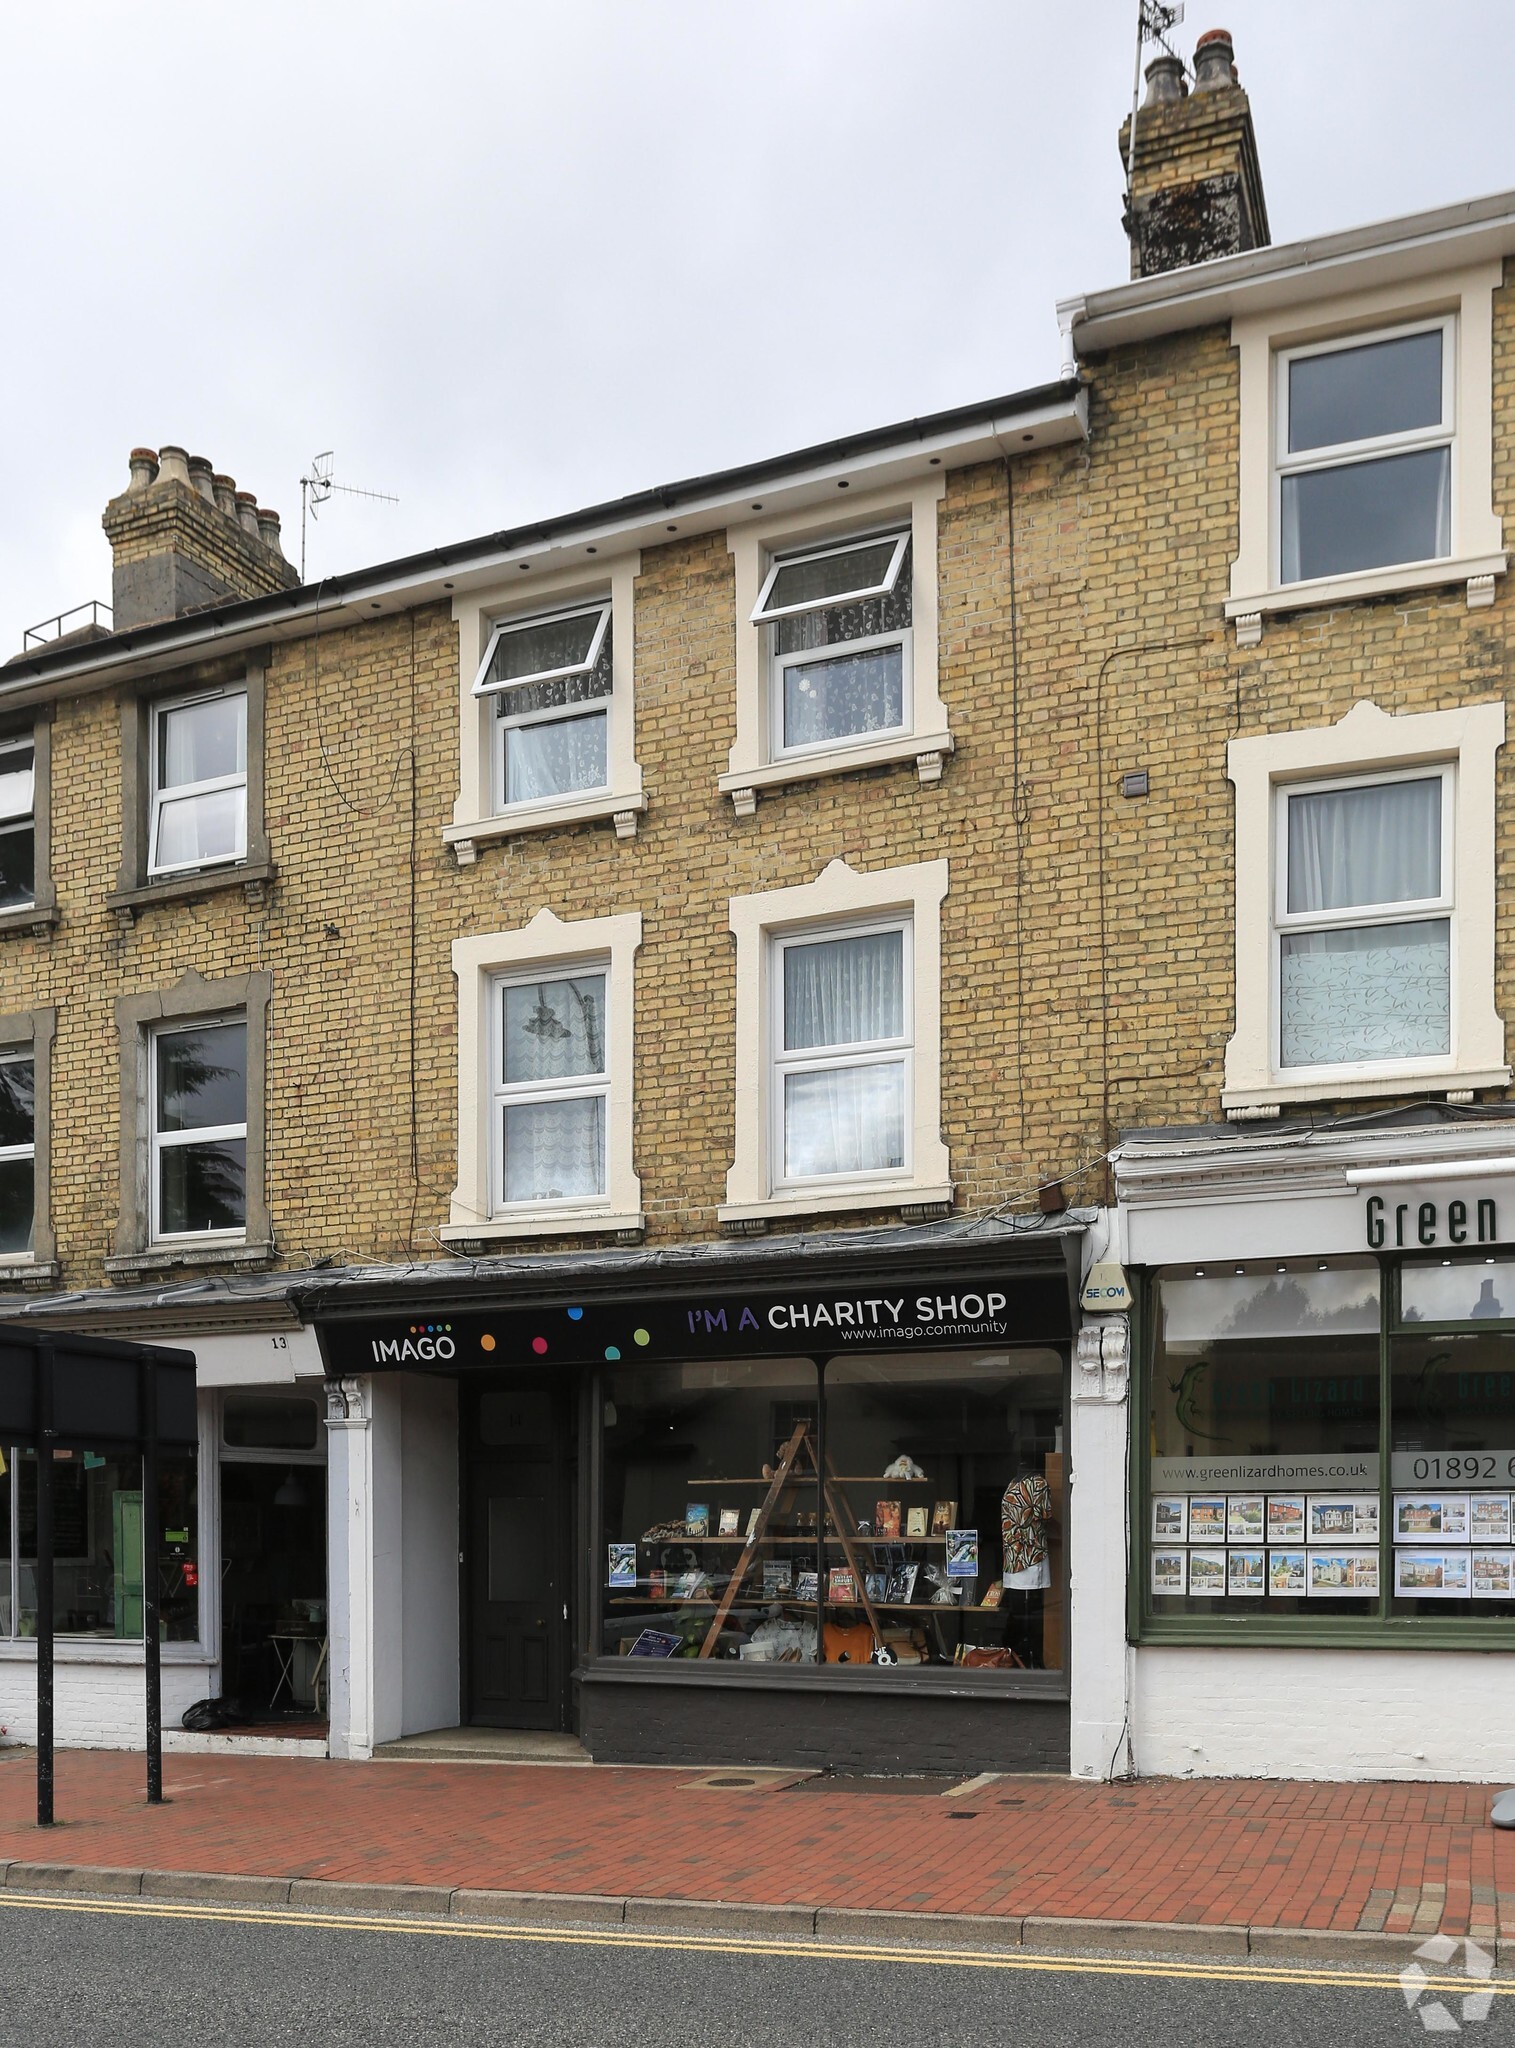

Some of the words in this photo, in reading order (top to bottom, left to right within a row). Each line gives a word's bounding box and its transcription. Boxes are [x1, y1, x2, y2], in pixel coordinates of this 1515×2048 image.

[1366, 1195, 1497, 1249] Green
[687, 1309, 728, 1333] I'M
[738, 1307, 760, 1331] A
[768, 1299, 904, 1330] CHARITY
[917, 1293, 1007, 1321] SHOP
[841, 1320, 1008, 1341] www.imago.community
[271, 1336, 287, 1349] 13
[371, 1336, 456, 1362] IMAGO
[1162, 1463, 1368, 1482] www.greenlizardhomes.co.uk
[1413, 1457, 1496, 1480] 01892
